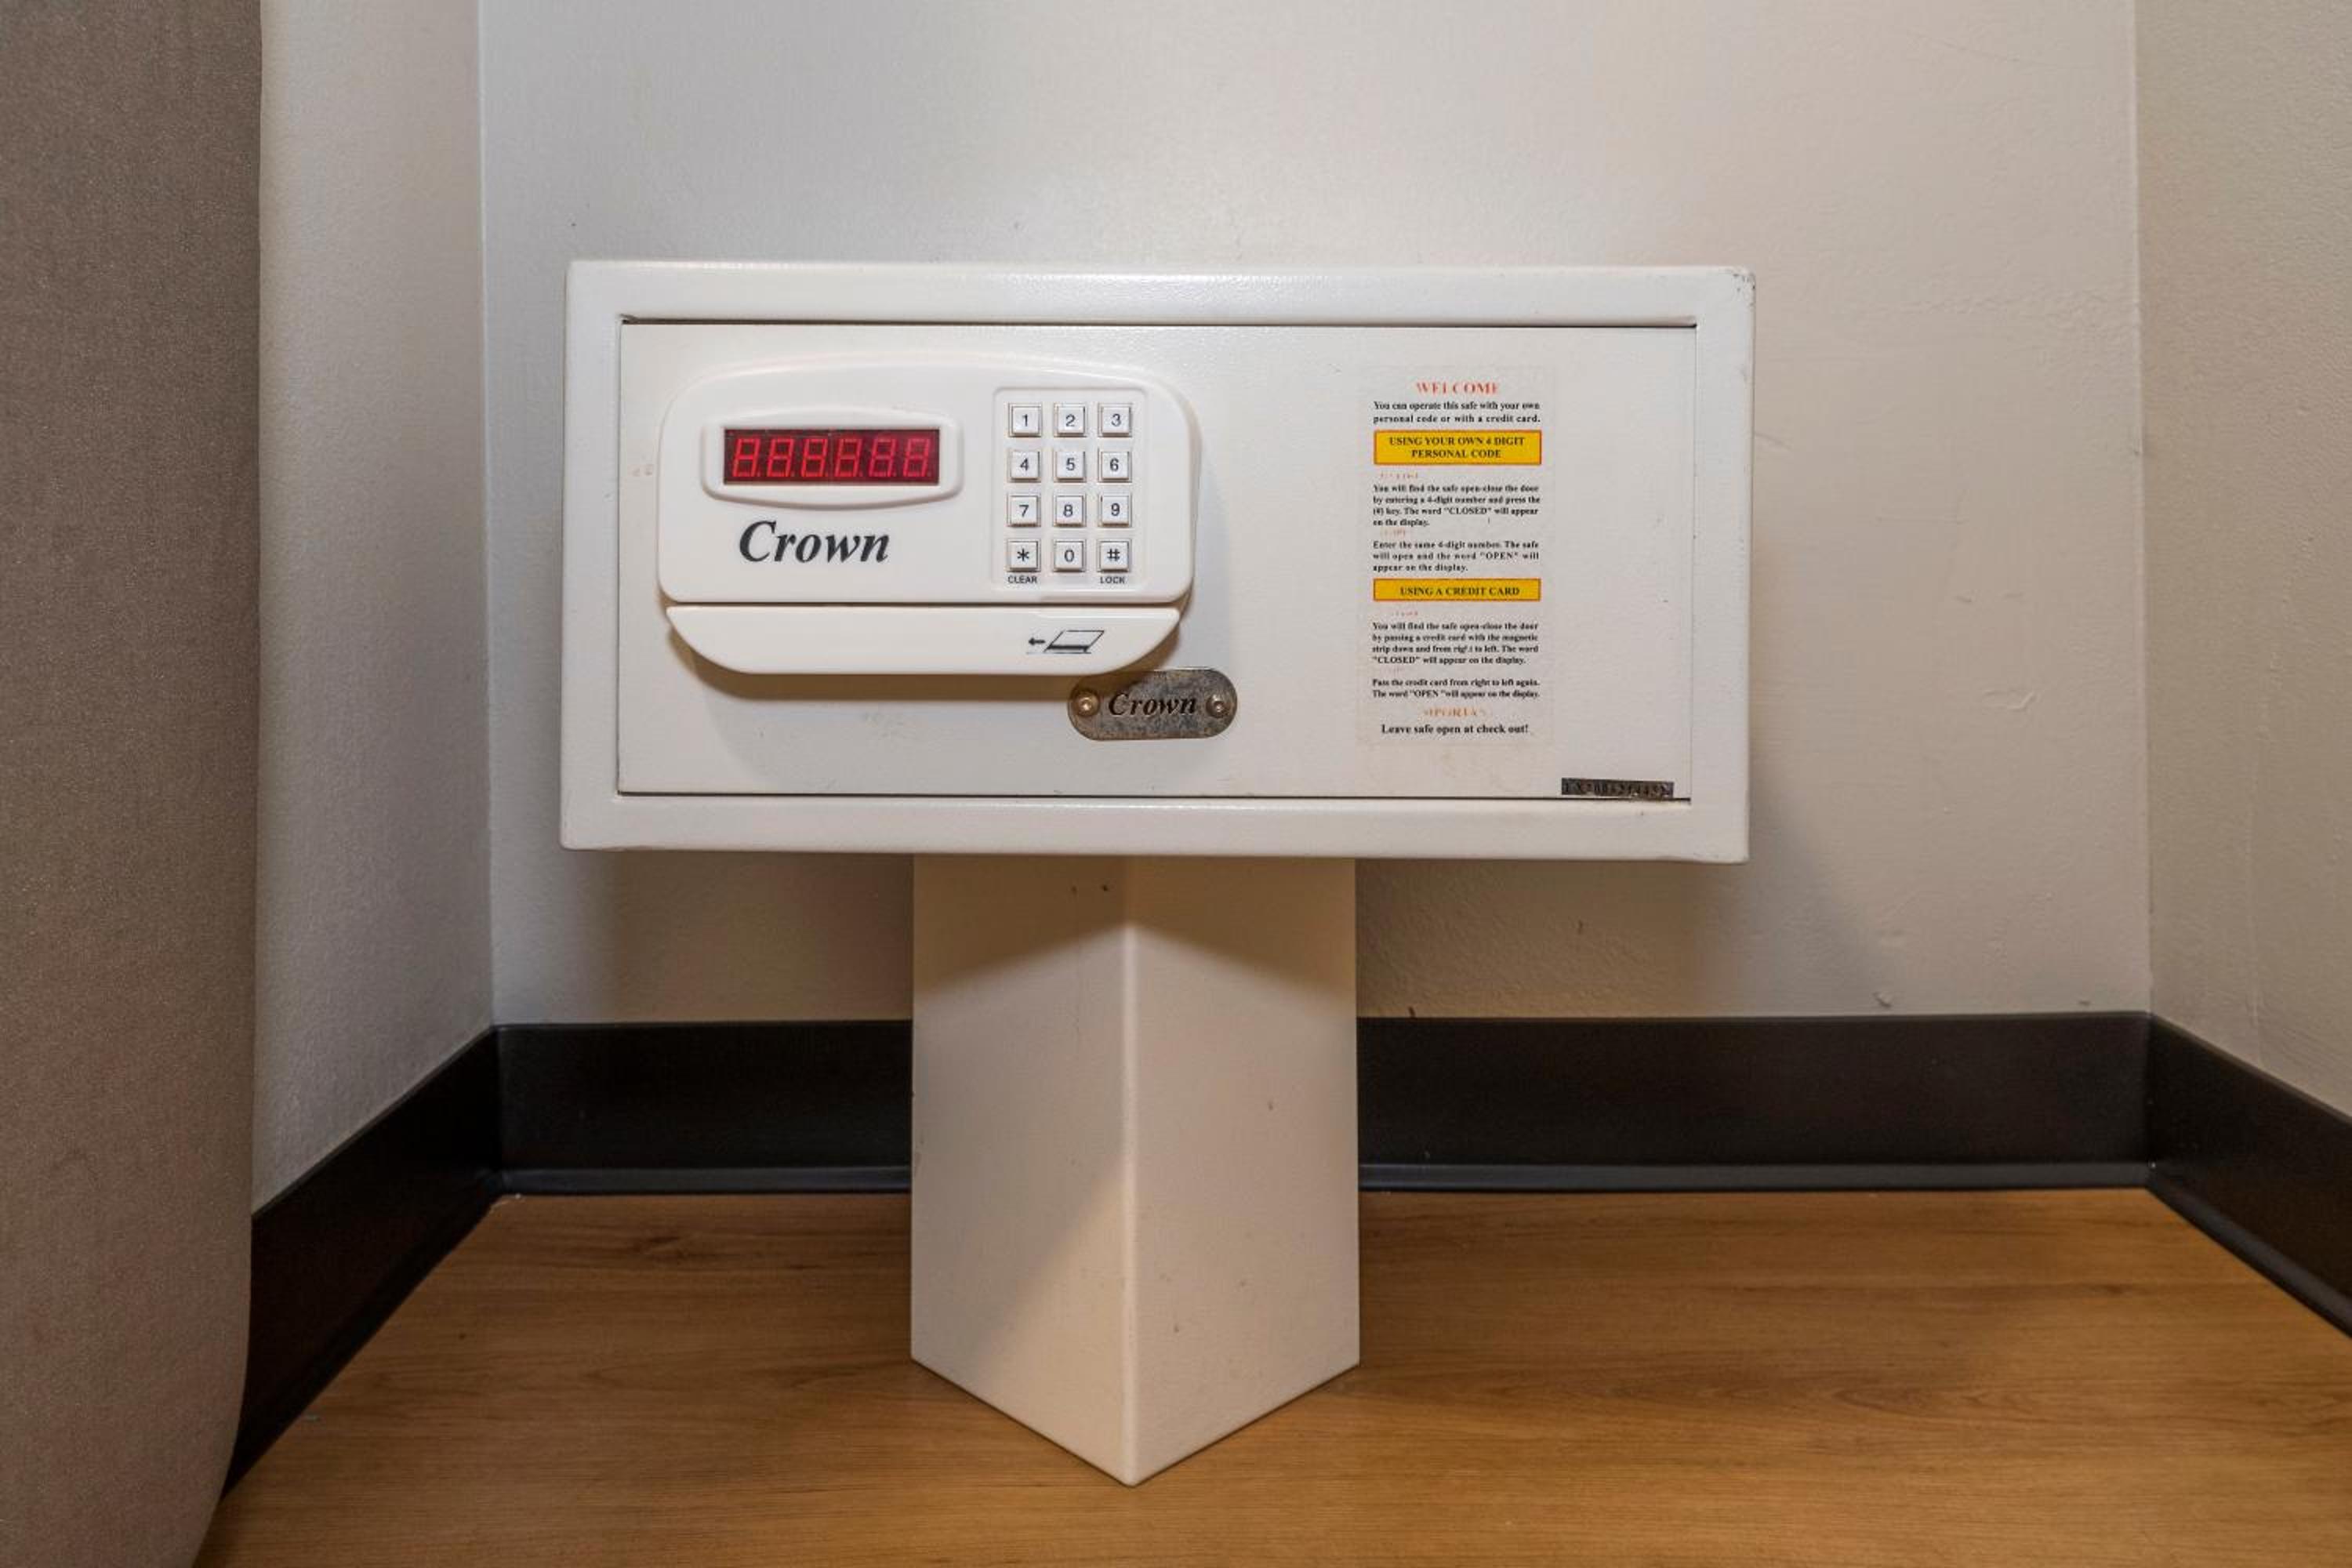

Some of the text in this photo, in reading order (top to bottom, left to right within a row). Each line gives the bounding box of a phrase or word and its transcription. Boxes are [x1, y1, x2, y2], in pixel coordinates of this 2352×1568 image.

[1410, 401, 1441, 411] operate
[1022, 414, 1121, 427] 1 2 3
[1373, 415, 1414, 424] personal
[1020, 458, 1120, 471] 4 5 6
[1019, 503, 1120, 517] 7 8 9
[739, 521, 890, 563] Crown
[1064, 550, 1075, 562] 0
[1107, 548, 1120, 561] #
[1108, 692, 1198, 716] Crown
[1436, 726, 1461, 735] open
